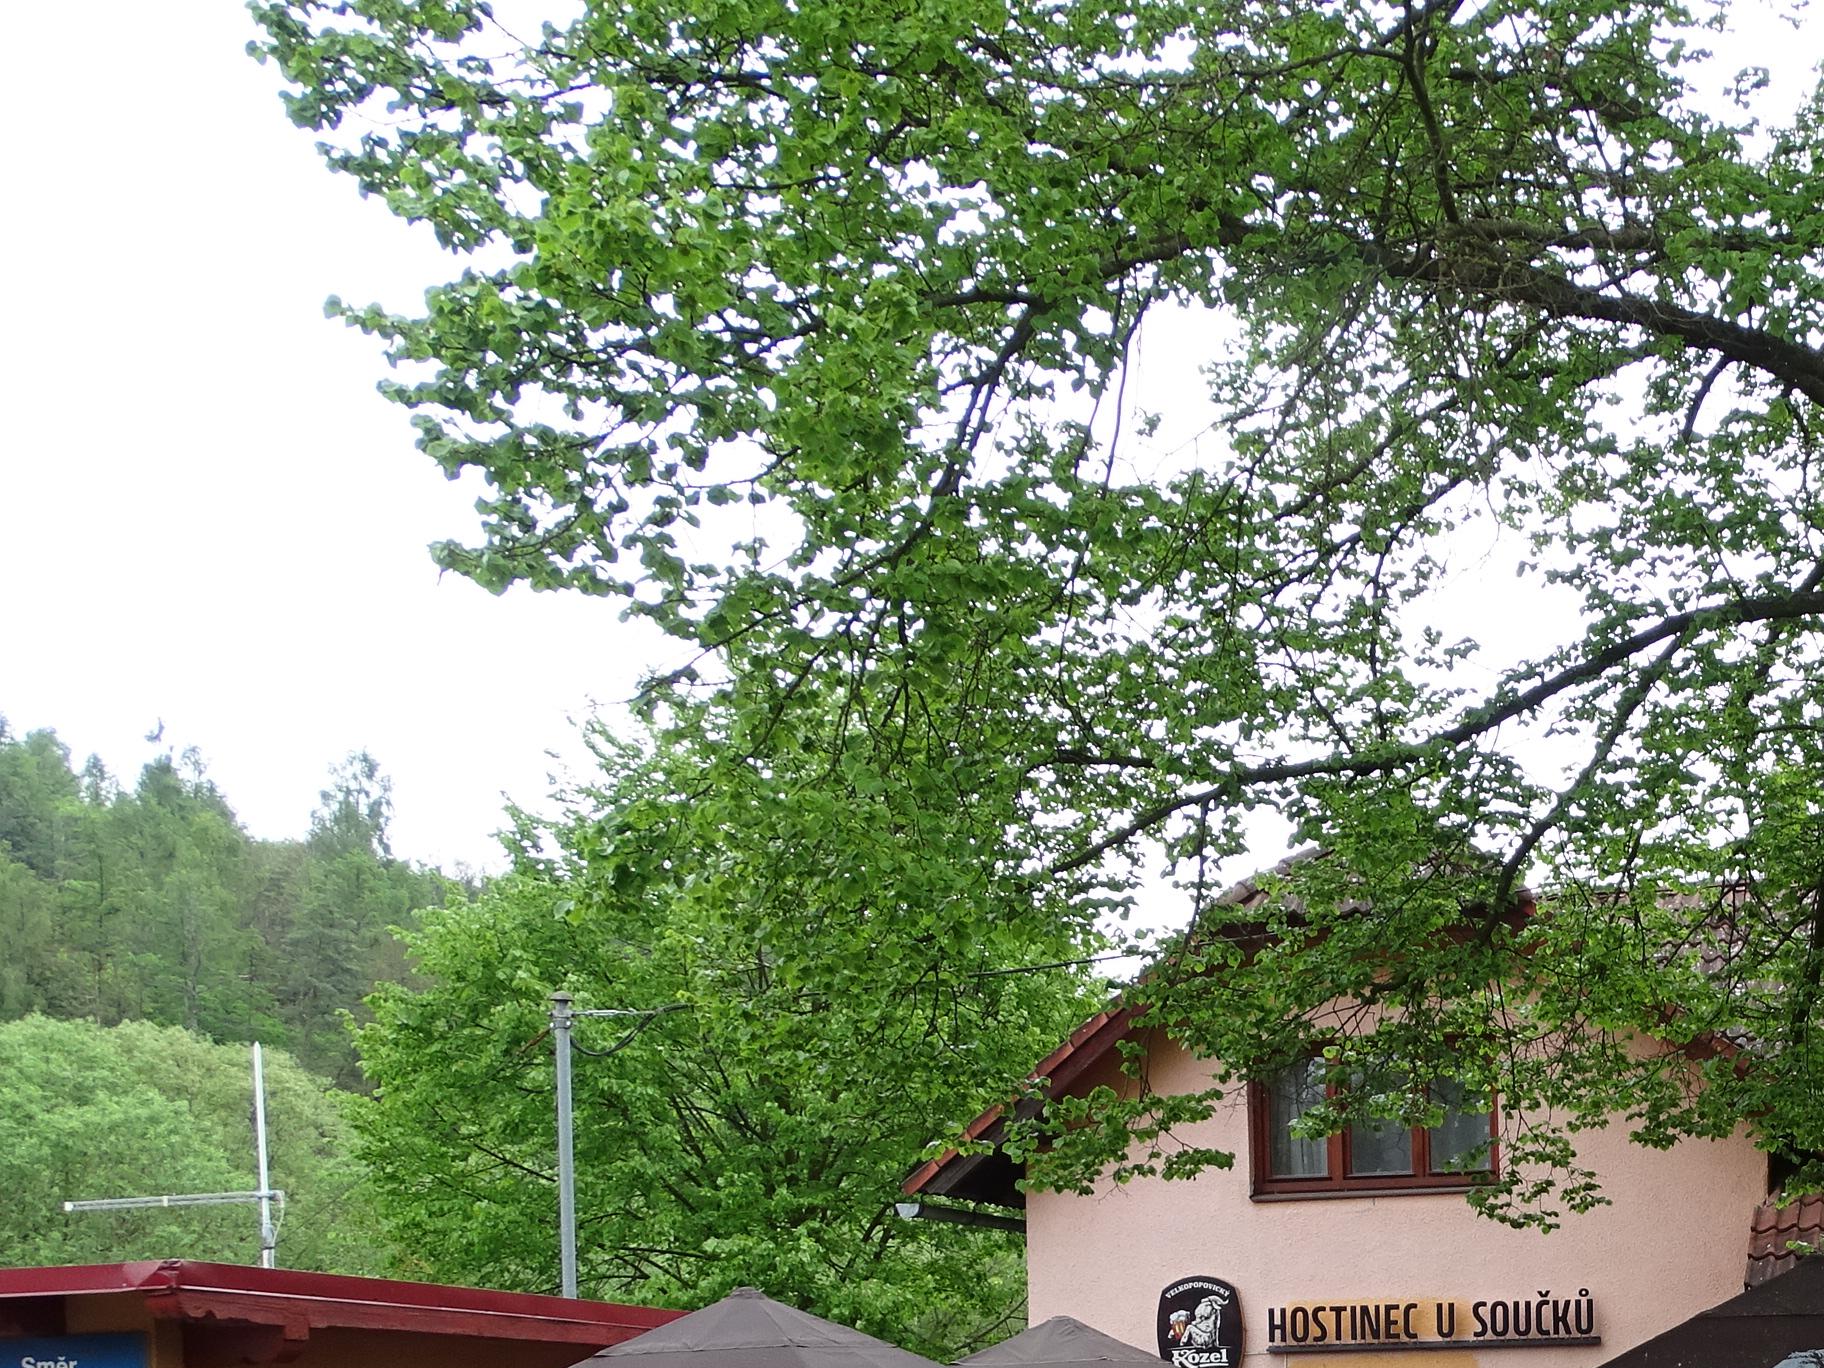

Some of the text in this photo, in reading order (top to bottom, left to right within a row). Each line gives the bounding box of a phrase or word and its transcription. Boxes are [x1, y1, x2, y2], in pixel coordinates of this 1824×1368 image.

[1268, 1288, 1595, 1343] HOSTINEC U SOUČKŮ
[1171, 1348, 1229, 1368] Kozel
